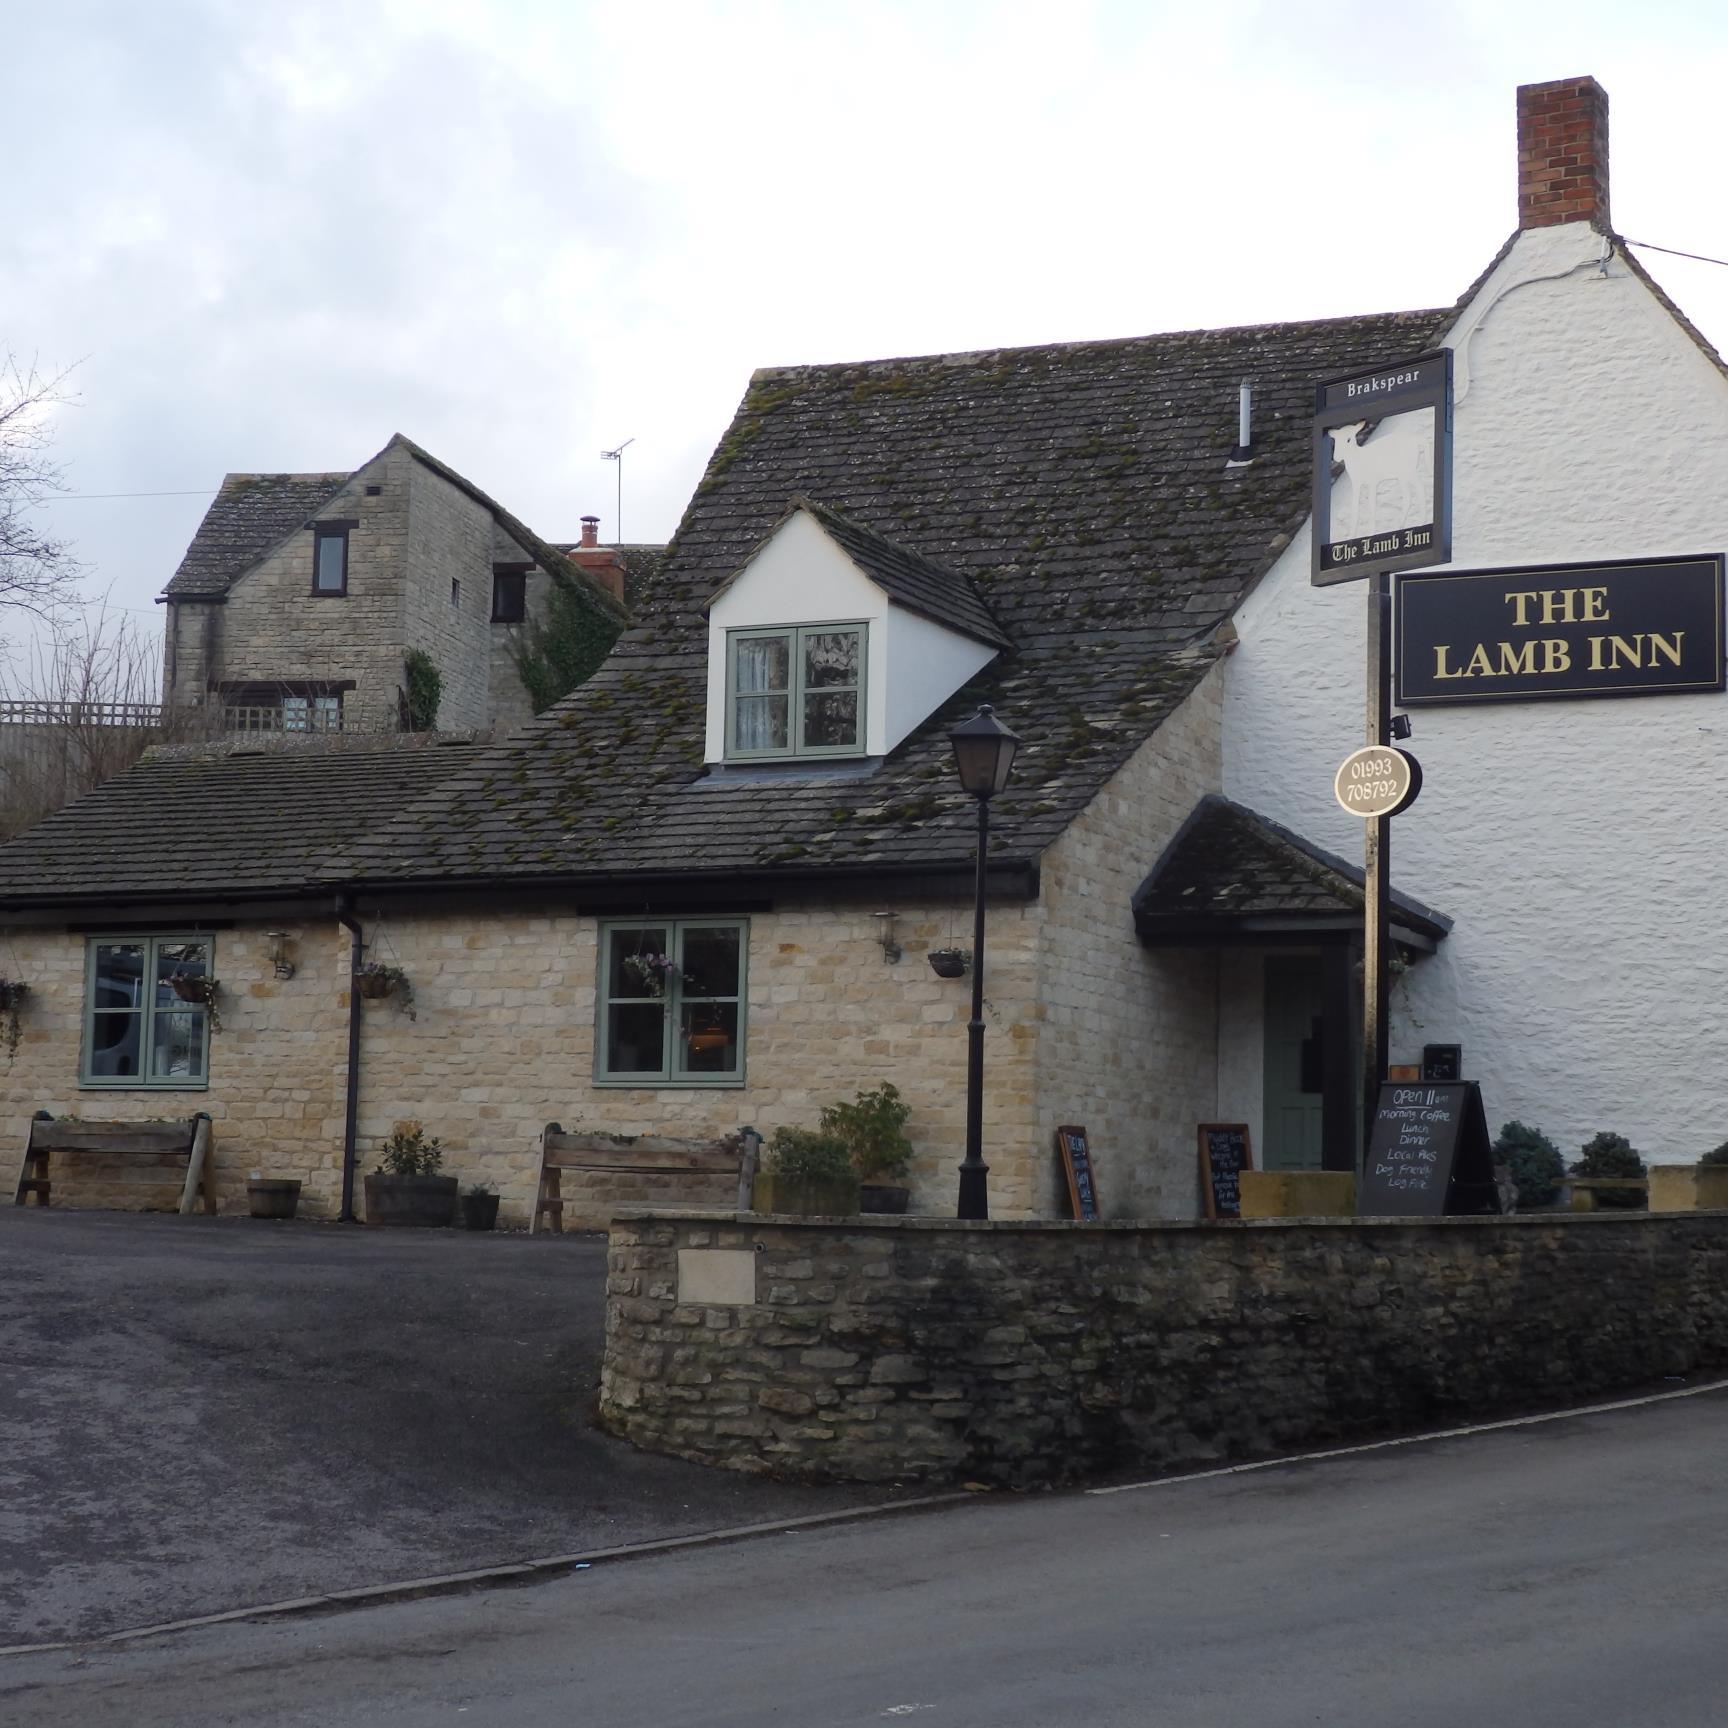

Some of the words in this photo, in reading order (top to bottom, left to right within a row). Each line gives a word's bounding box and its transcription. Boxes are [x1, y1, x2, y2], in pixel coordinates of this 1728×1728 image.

[1347, 368, 1421, 398] Brakspear
[1331, 543, 1357, 562] The
[1361, 534, 1400, 555] Lamb
[1403, 528, 1431, 550] Inn
[1504, 586, 1611, 626] THE
[1433, 638, 1572, 679] LAMB
[1587, 631, 1686, 671] INN
[1351, 757, 1392, 779] 01993
[1347, 779, 1397, 802] 708792
